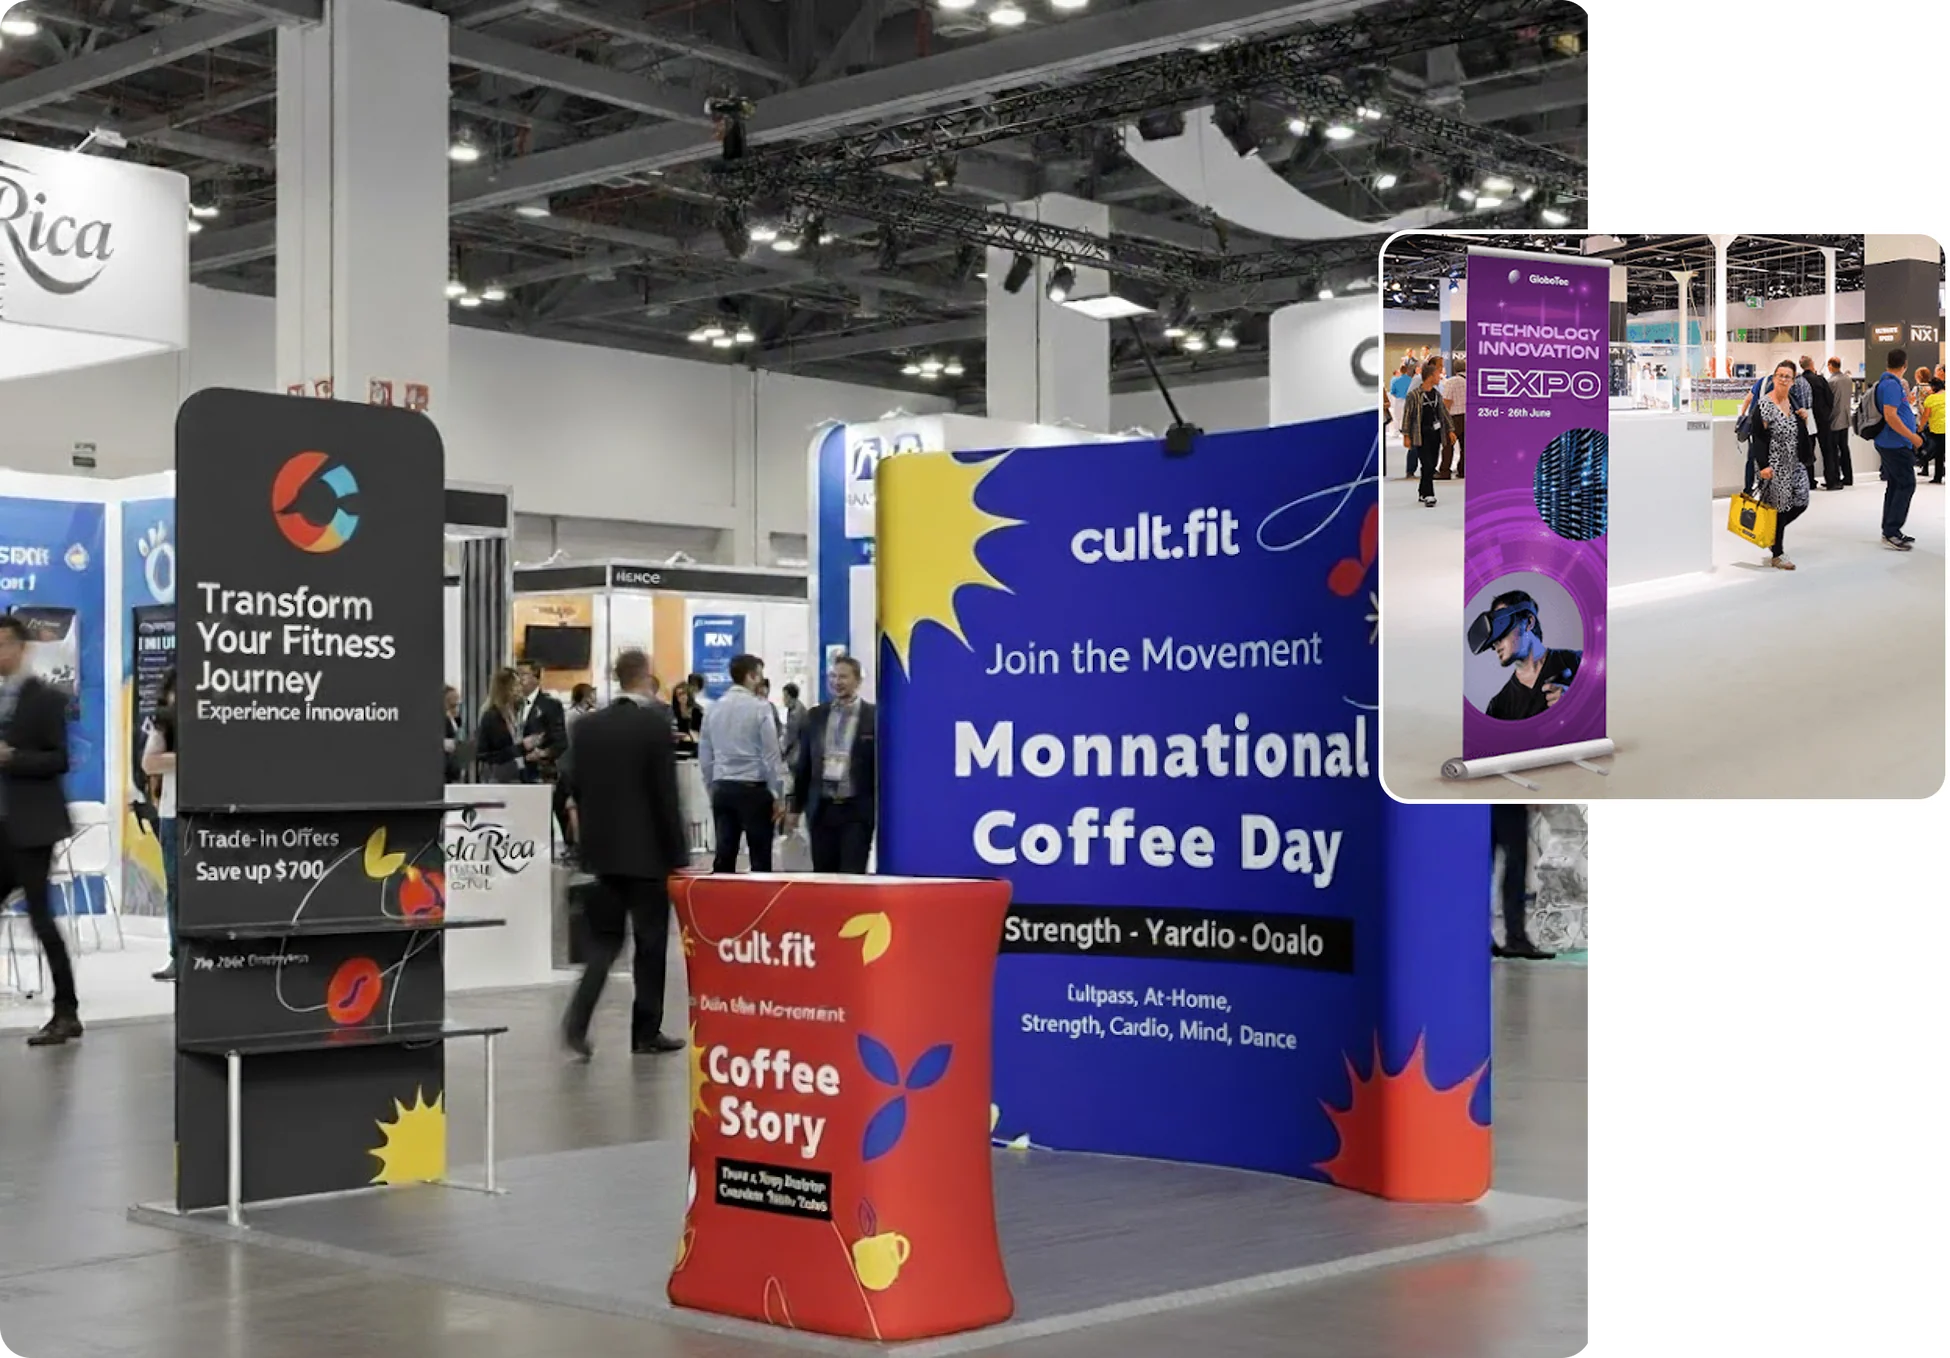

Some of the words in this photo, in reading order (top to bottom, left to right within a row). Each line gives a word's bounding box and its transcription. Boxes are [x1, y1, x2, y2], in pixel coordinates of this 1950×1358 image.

[1478, 322, 1600, 342] TECHNOLOGY
[1478, 341, 1600, 360] INNOVATION
[1911, 328, 1939, 343] NX1
[1478, 368, 1601, 399] EXPO
[1478, 408, 1499, 417] 23rd
[1508, 408, 1528, 417] 26th
[1530, 408, 1551, 417] June
[1071, 506, 1240, 564] cult.fit
[197, 582, 373, 621] Transform
[196, 621, 272, 654] Your
[283, 624, 396, 659] Fitness
[985, 641, 1060, 675] Join
[1071, 638, 1131, 674] the
[1142, 632, 1324, 672] Movement
[196, 660, 323, 702] Journey
[197, 699, 301, 724] Experience
[954, 712, 1370, 778] Monnational
[972, 806, 1215, 867] Coffee
[1241, 813, 1343, 889] Day
[196, 861, 241, 881] Save
[244, 864, 271, 884] up
[274, 858, 325, 882] $700
[717, 930, 816, 969] cult.fit
[1004, 915, 1122, 950] Strength
[1145, 918, 1235, 949] Yardio
[1143, 987, 1232, 1013] At-Home,
[1021, 1014, 1105, 1040] Strength,
[1109, 1016, 1174, 1041] Cardio,
[1179, 1020, 1233, 1046] Mind,
[1240, 1025, 1297, 1050] Dance
[708, 1045, 840, 1096] Coffee
[719, 1095, 826, 1159] Story
